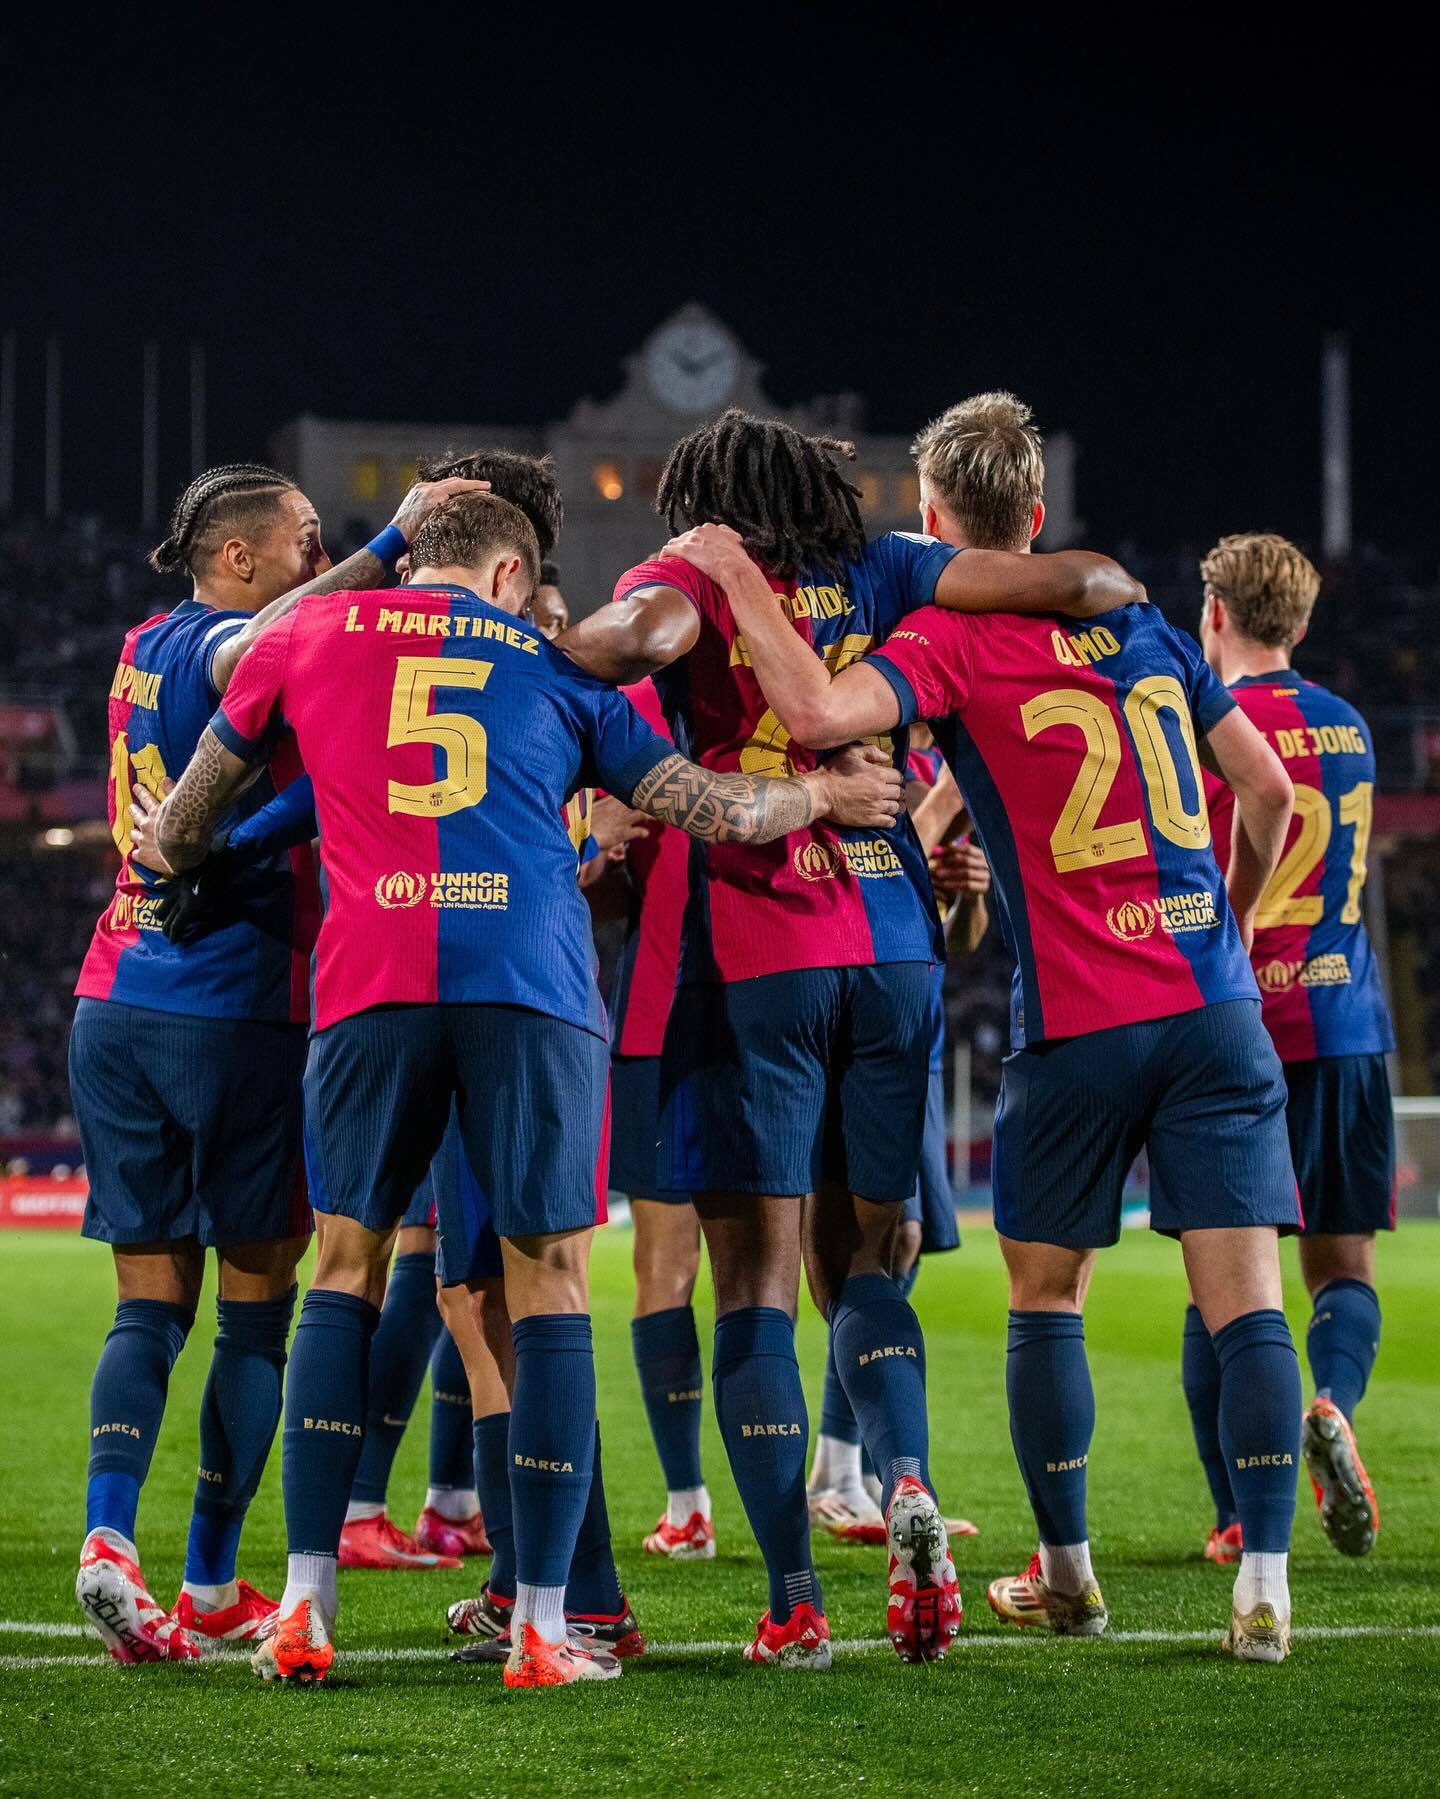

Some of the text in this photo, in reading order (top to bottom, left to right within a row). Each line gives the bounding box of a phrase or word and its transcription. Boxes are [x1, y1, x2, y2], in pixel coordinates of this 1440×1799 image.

[376, 608, 539, 655] MARTINEZ
[387, 656, 495, 817] 5
[1305, 725, 1367, 757] JONG
[1019, 675, 1212, 874] 20
[1253, 782, 1374, 930] 21
[431, 872, 509, 888] UNHCR
[430, 887, 508, 904] ACNUR
[1152, 891, 1214, 913] UNHCR
[483, 903, 508, 912] Agency
[1160, 907, 1219, 928] ACNUR
[303, 1417, 362, 1438] BARÇA
[741, 1423, 800, 1438] BARÇA
[514, 1453, 574, 1473] BARÇA
